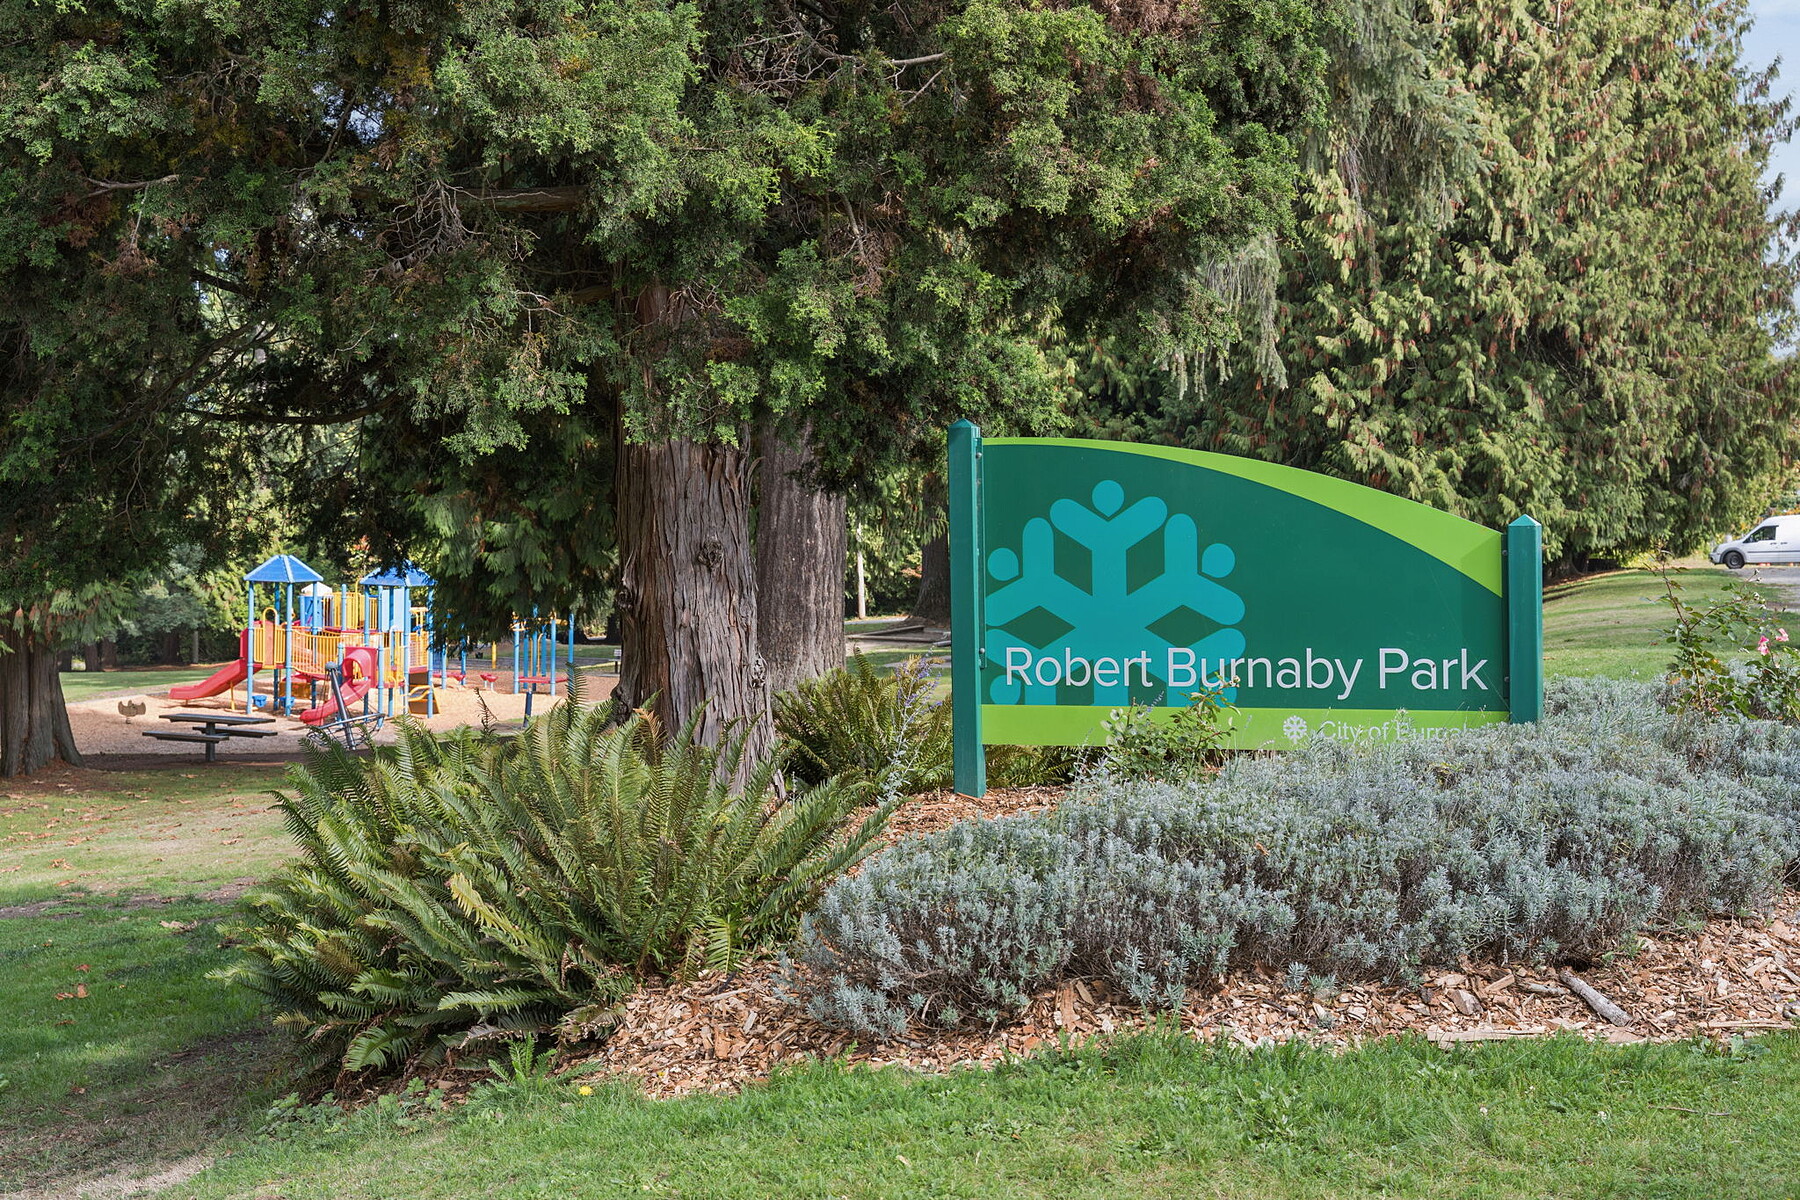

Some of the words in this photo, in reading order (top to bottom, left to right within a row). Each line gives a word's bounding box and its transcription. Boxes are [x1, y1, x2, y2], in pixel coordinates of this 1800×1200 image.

[1005, 646, 1154, 688] Robert
[1167, 646, 1364, 701] Burnaby
[1378, 646, 1489, 691] Park
[1319, 720, 1362, 745] City
[1368, 721, 1390, 741] of
